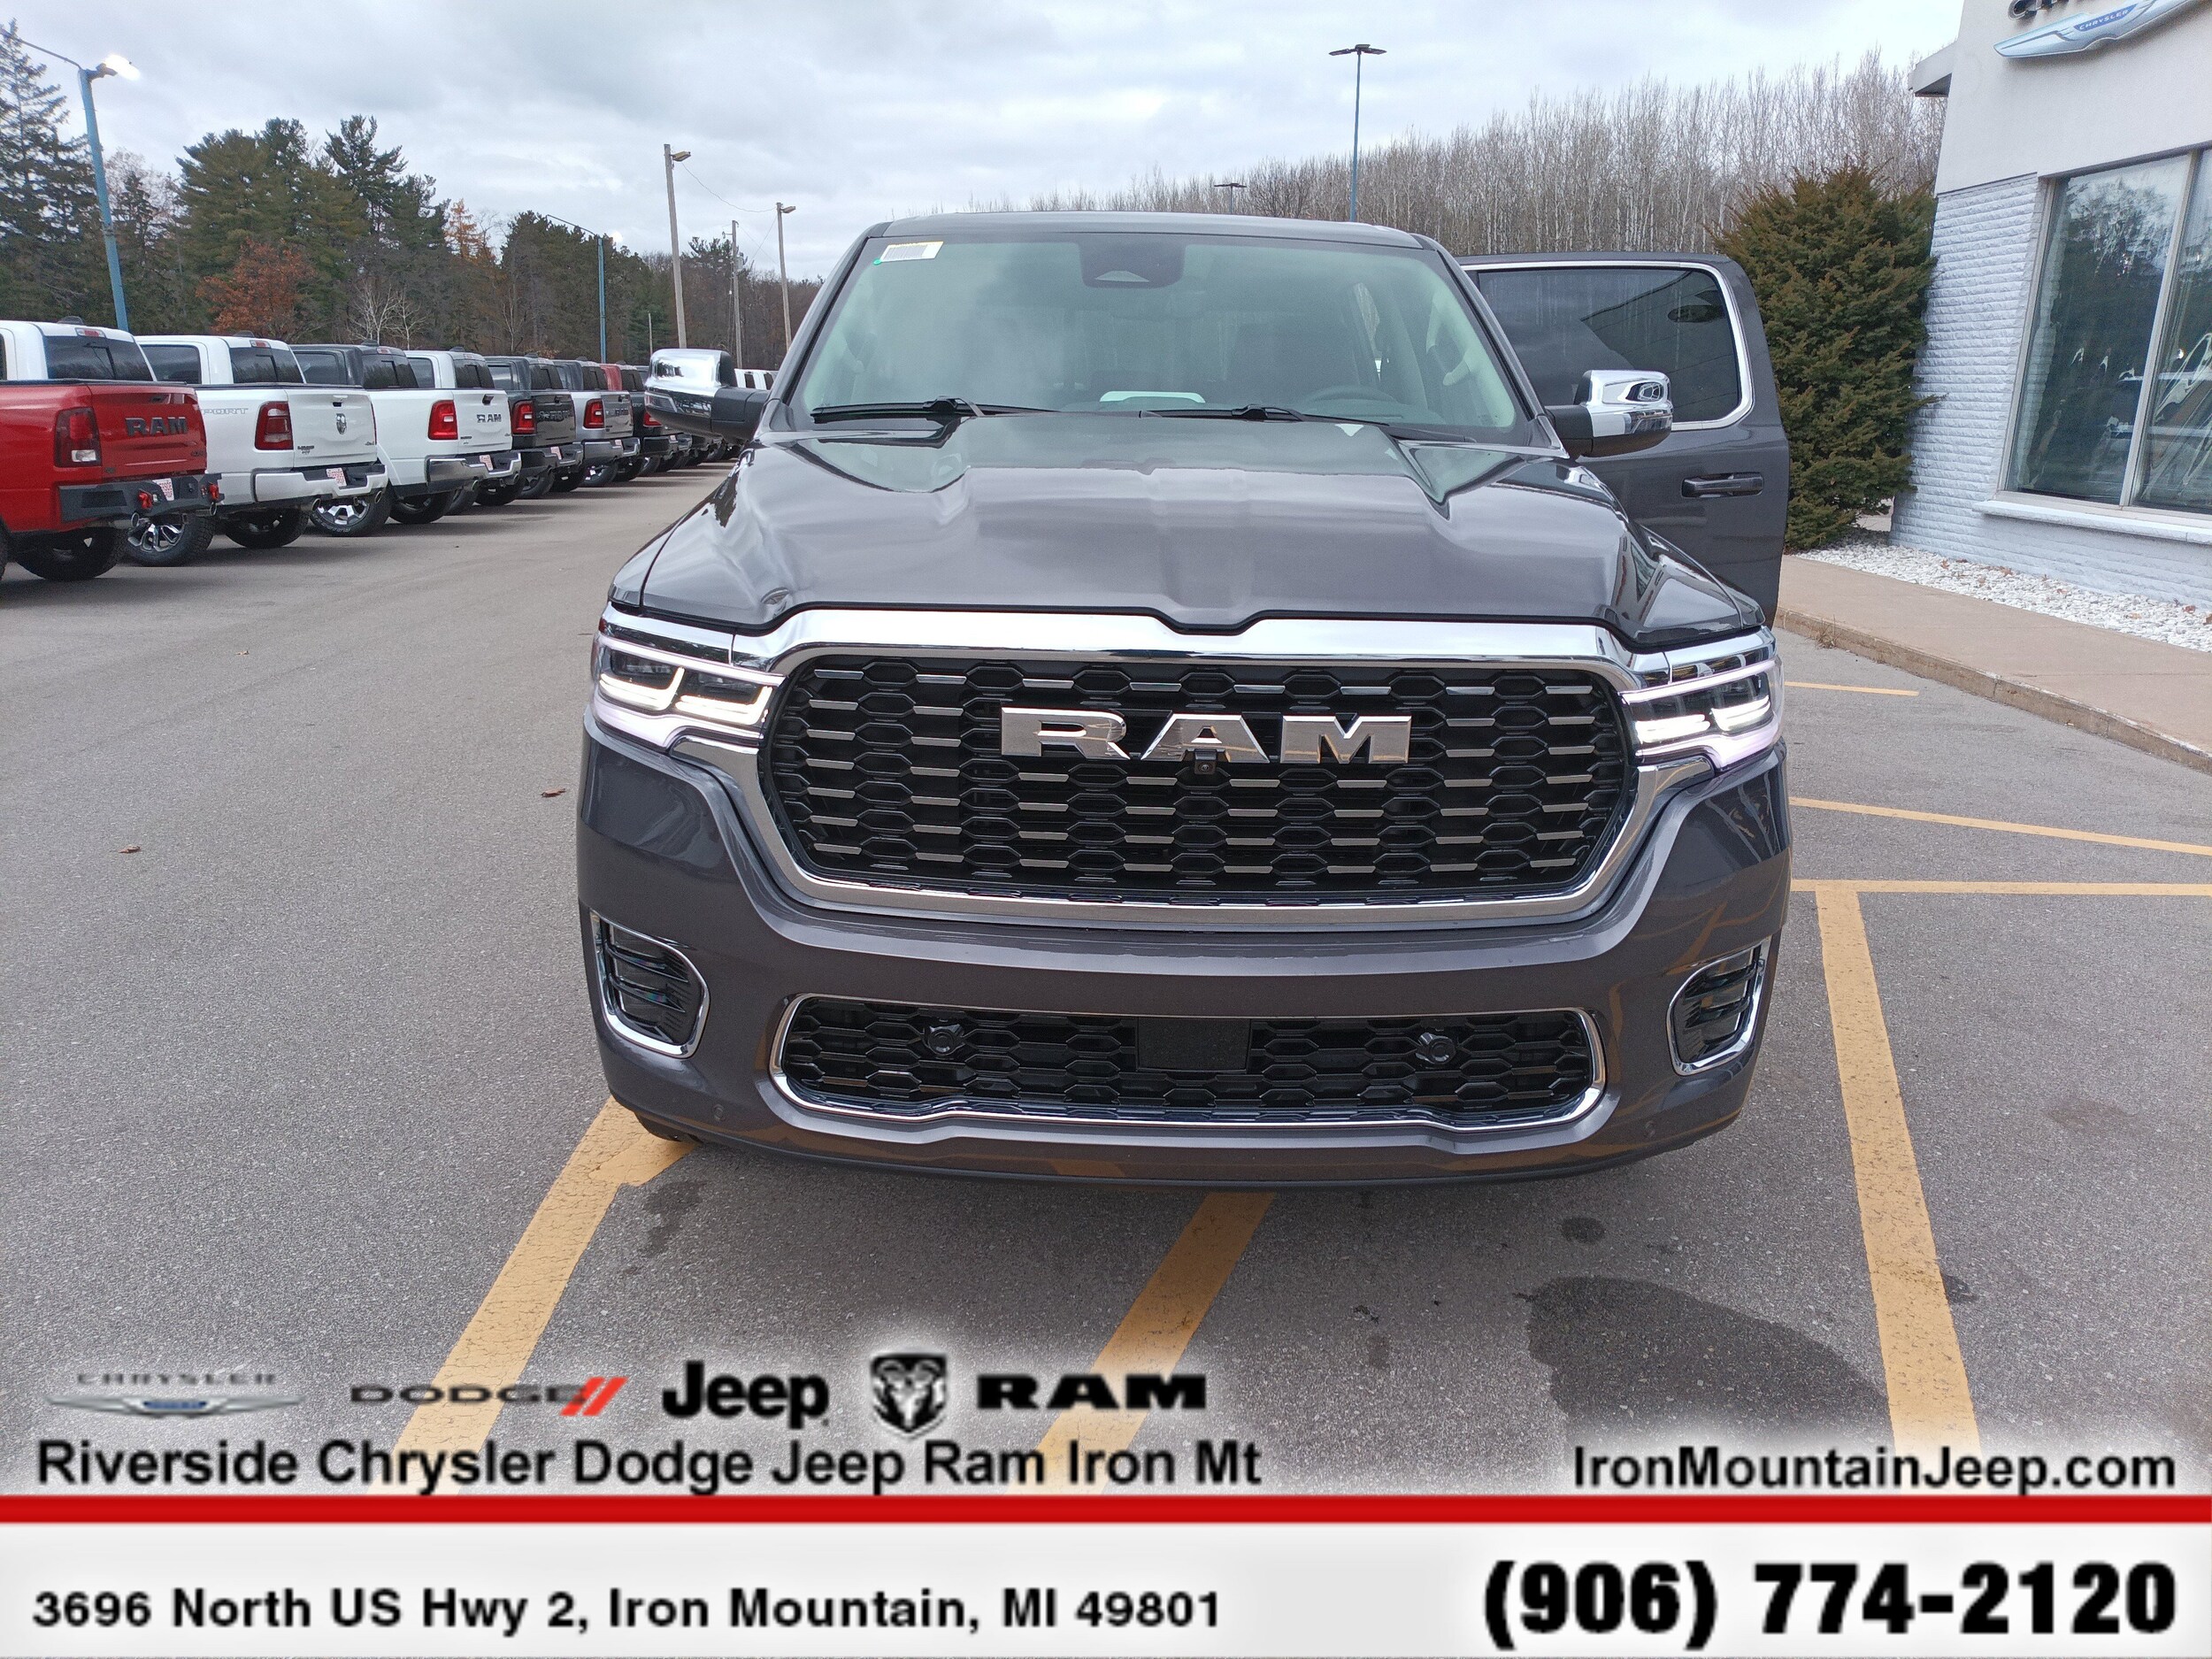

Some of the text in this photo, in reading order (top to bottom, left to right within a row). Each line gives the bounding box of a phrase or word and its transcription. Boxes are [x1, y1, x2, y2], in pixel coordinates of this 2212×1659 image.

[2079, 9, 2129, 30] CHRYSLER
[125, 416, 188, 436] RAM
[476, 413, 502, 423] RAM
[1001, 706, 1412, 764] RAM
